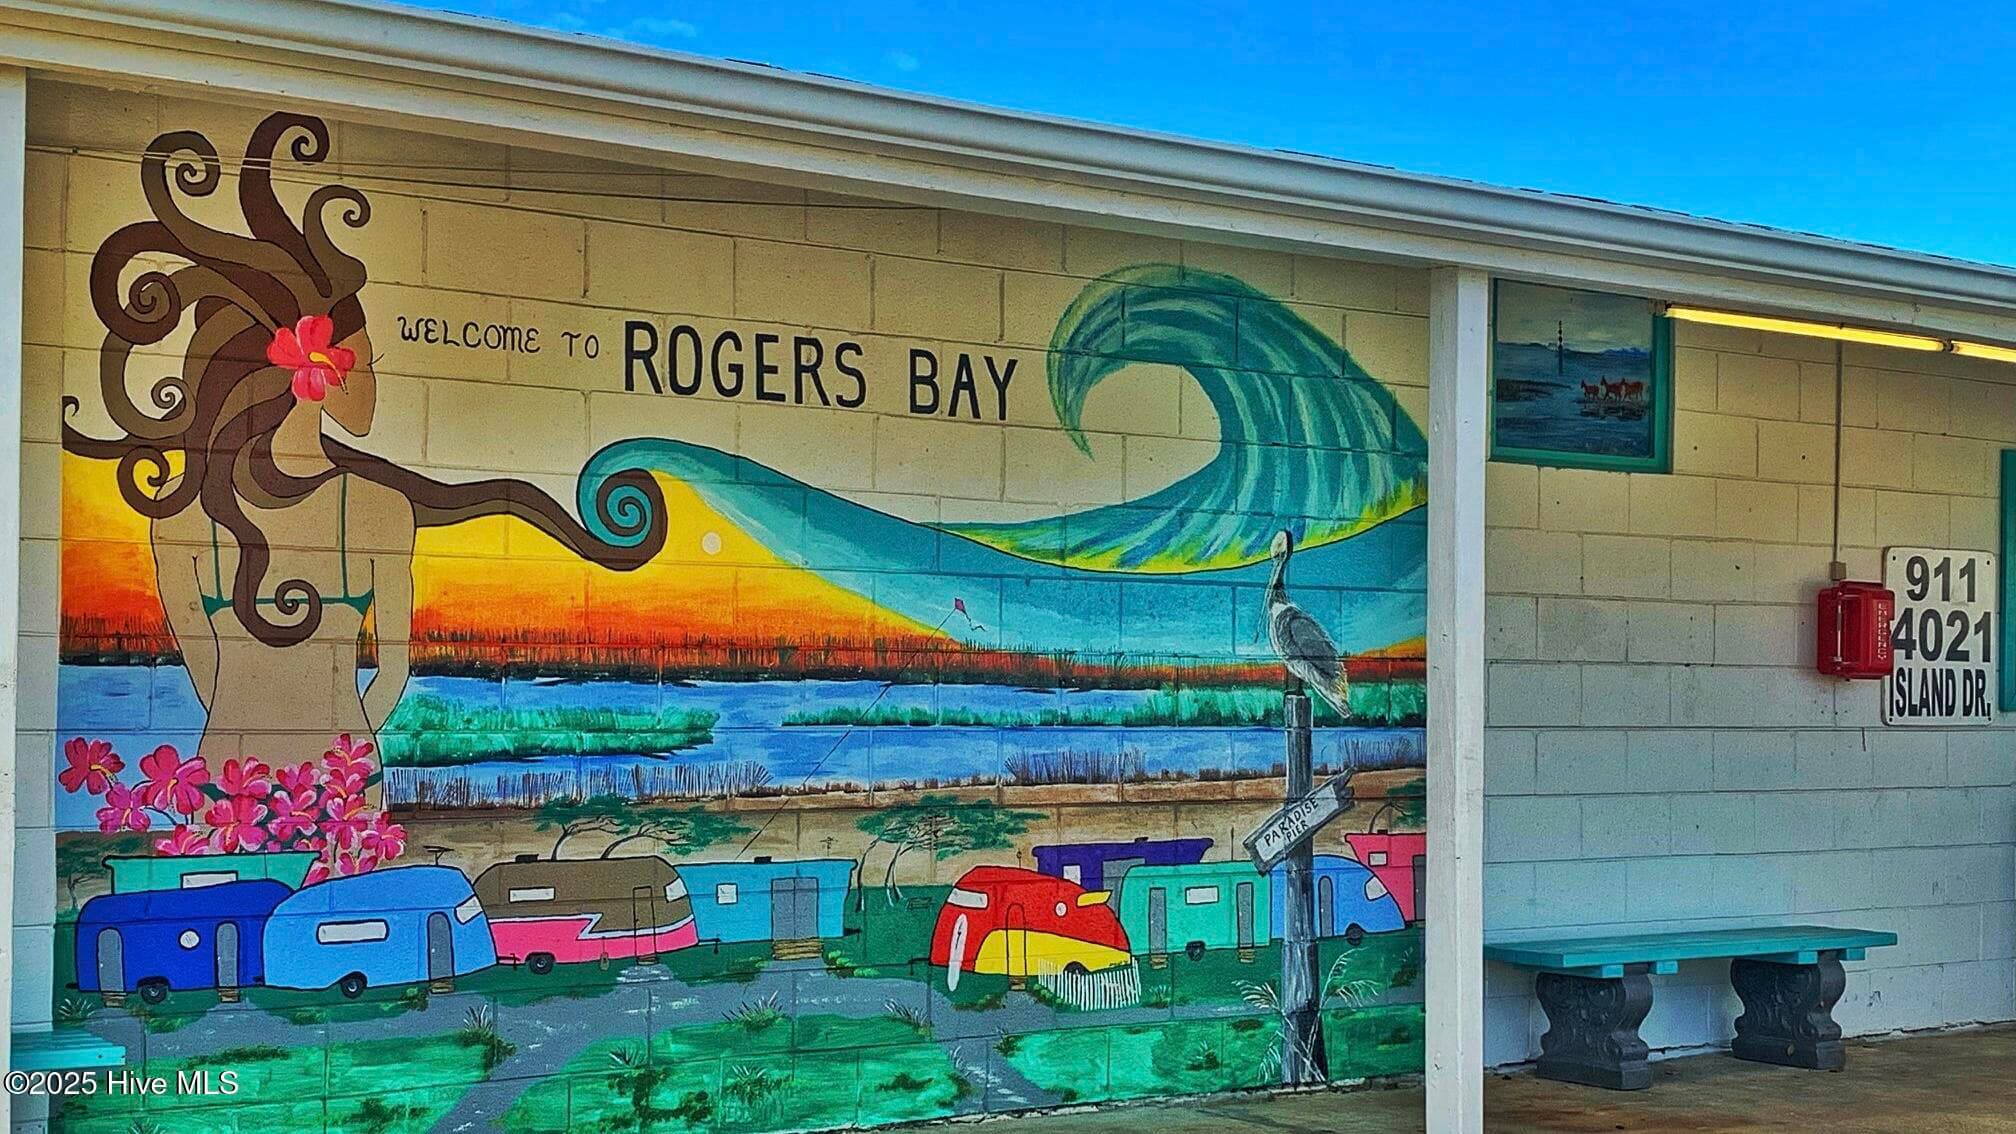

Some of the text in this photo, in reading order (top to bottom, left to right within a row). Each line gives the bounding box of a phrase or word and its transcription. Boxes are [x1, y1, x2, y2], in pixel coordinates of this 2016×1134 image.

[397, 316, 1019, 422] WELCOME TO ROGERS BAY
[1906, 555, 1976, 603] 911
[1891, 607, 1991, 663] 4021
[1889, 667, 1991, 718] ISLAND DR.
[1263, 795, 1319, 847] PARADISE
[1285, 819, 1309, 843] PIER
